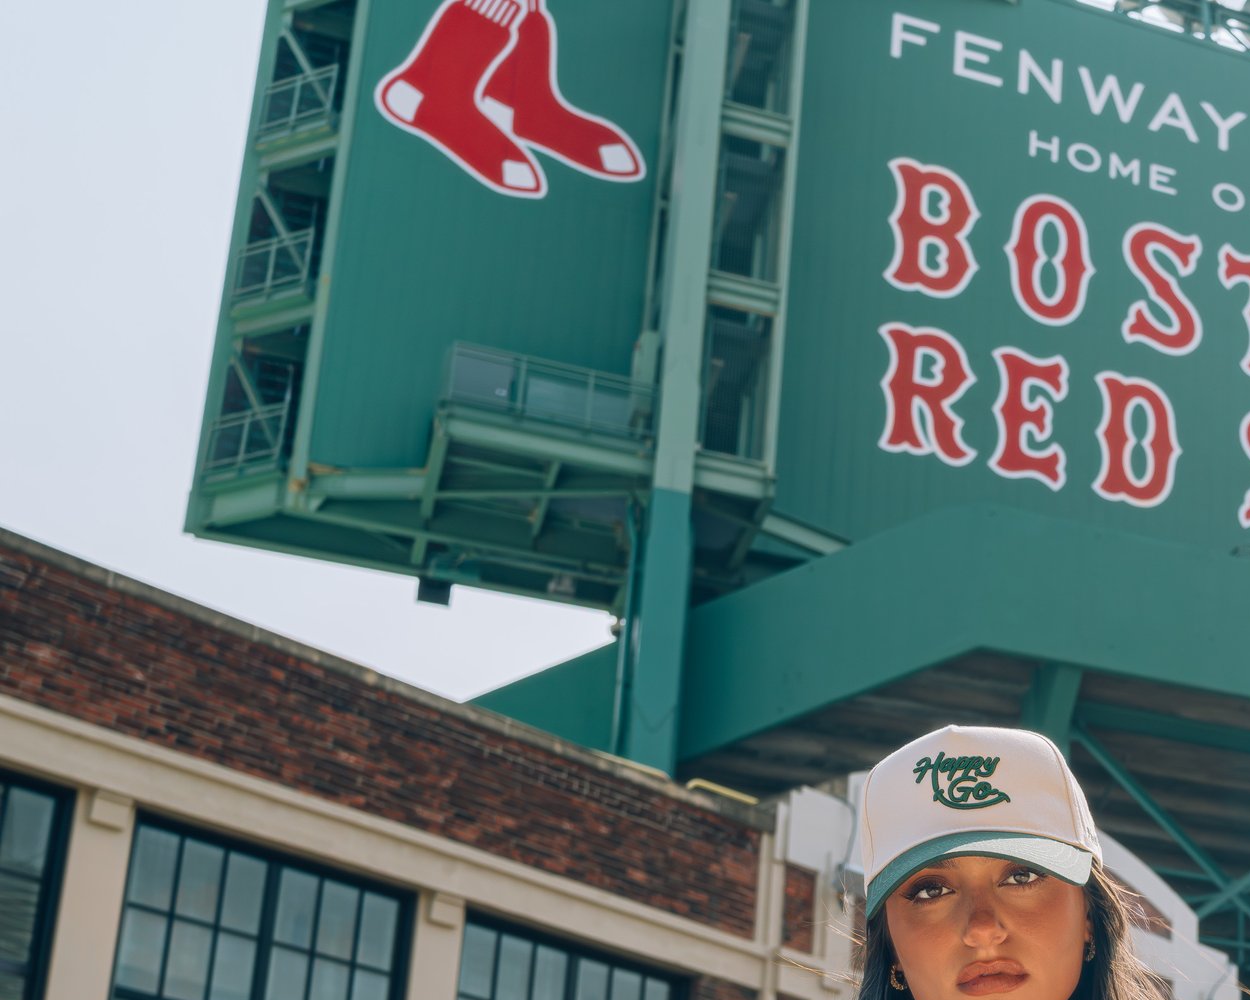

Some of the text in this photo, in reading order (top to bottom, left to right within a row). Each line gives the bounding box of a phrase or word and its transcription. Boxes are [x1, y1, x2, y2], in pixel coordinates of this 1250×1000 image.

[890, 13, 1247, 151] FENWAY
[1029, 131, 1178, 195] HOME
[877, 321, 1181, 508] RED
[912, 751, 1001, 793] Happy
[948, 776, 1000, 804] Go
